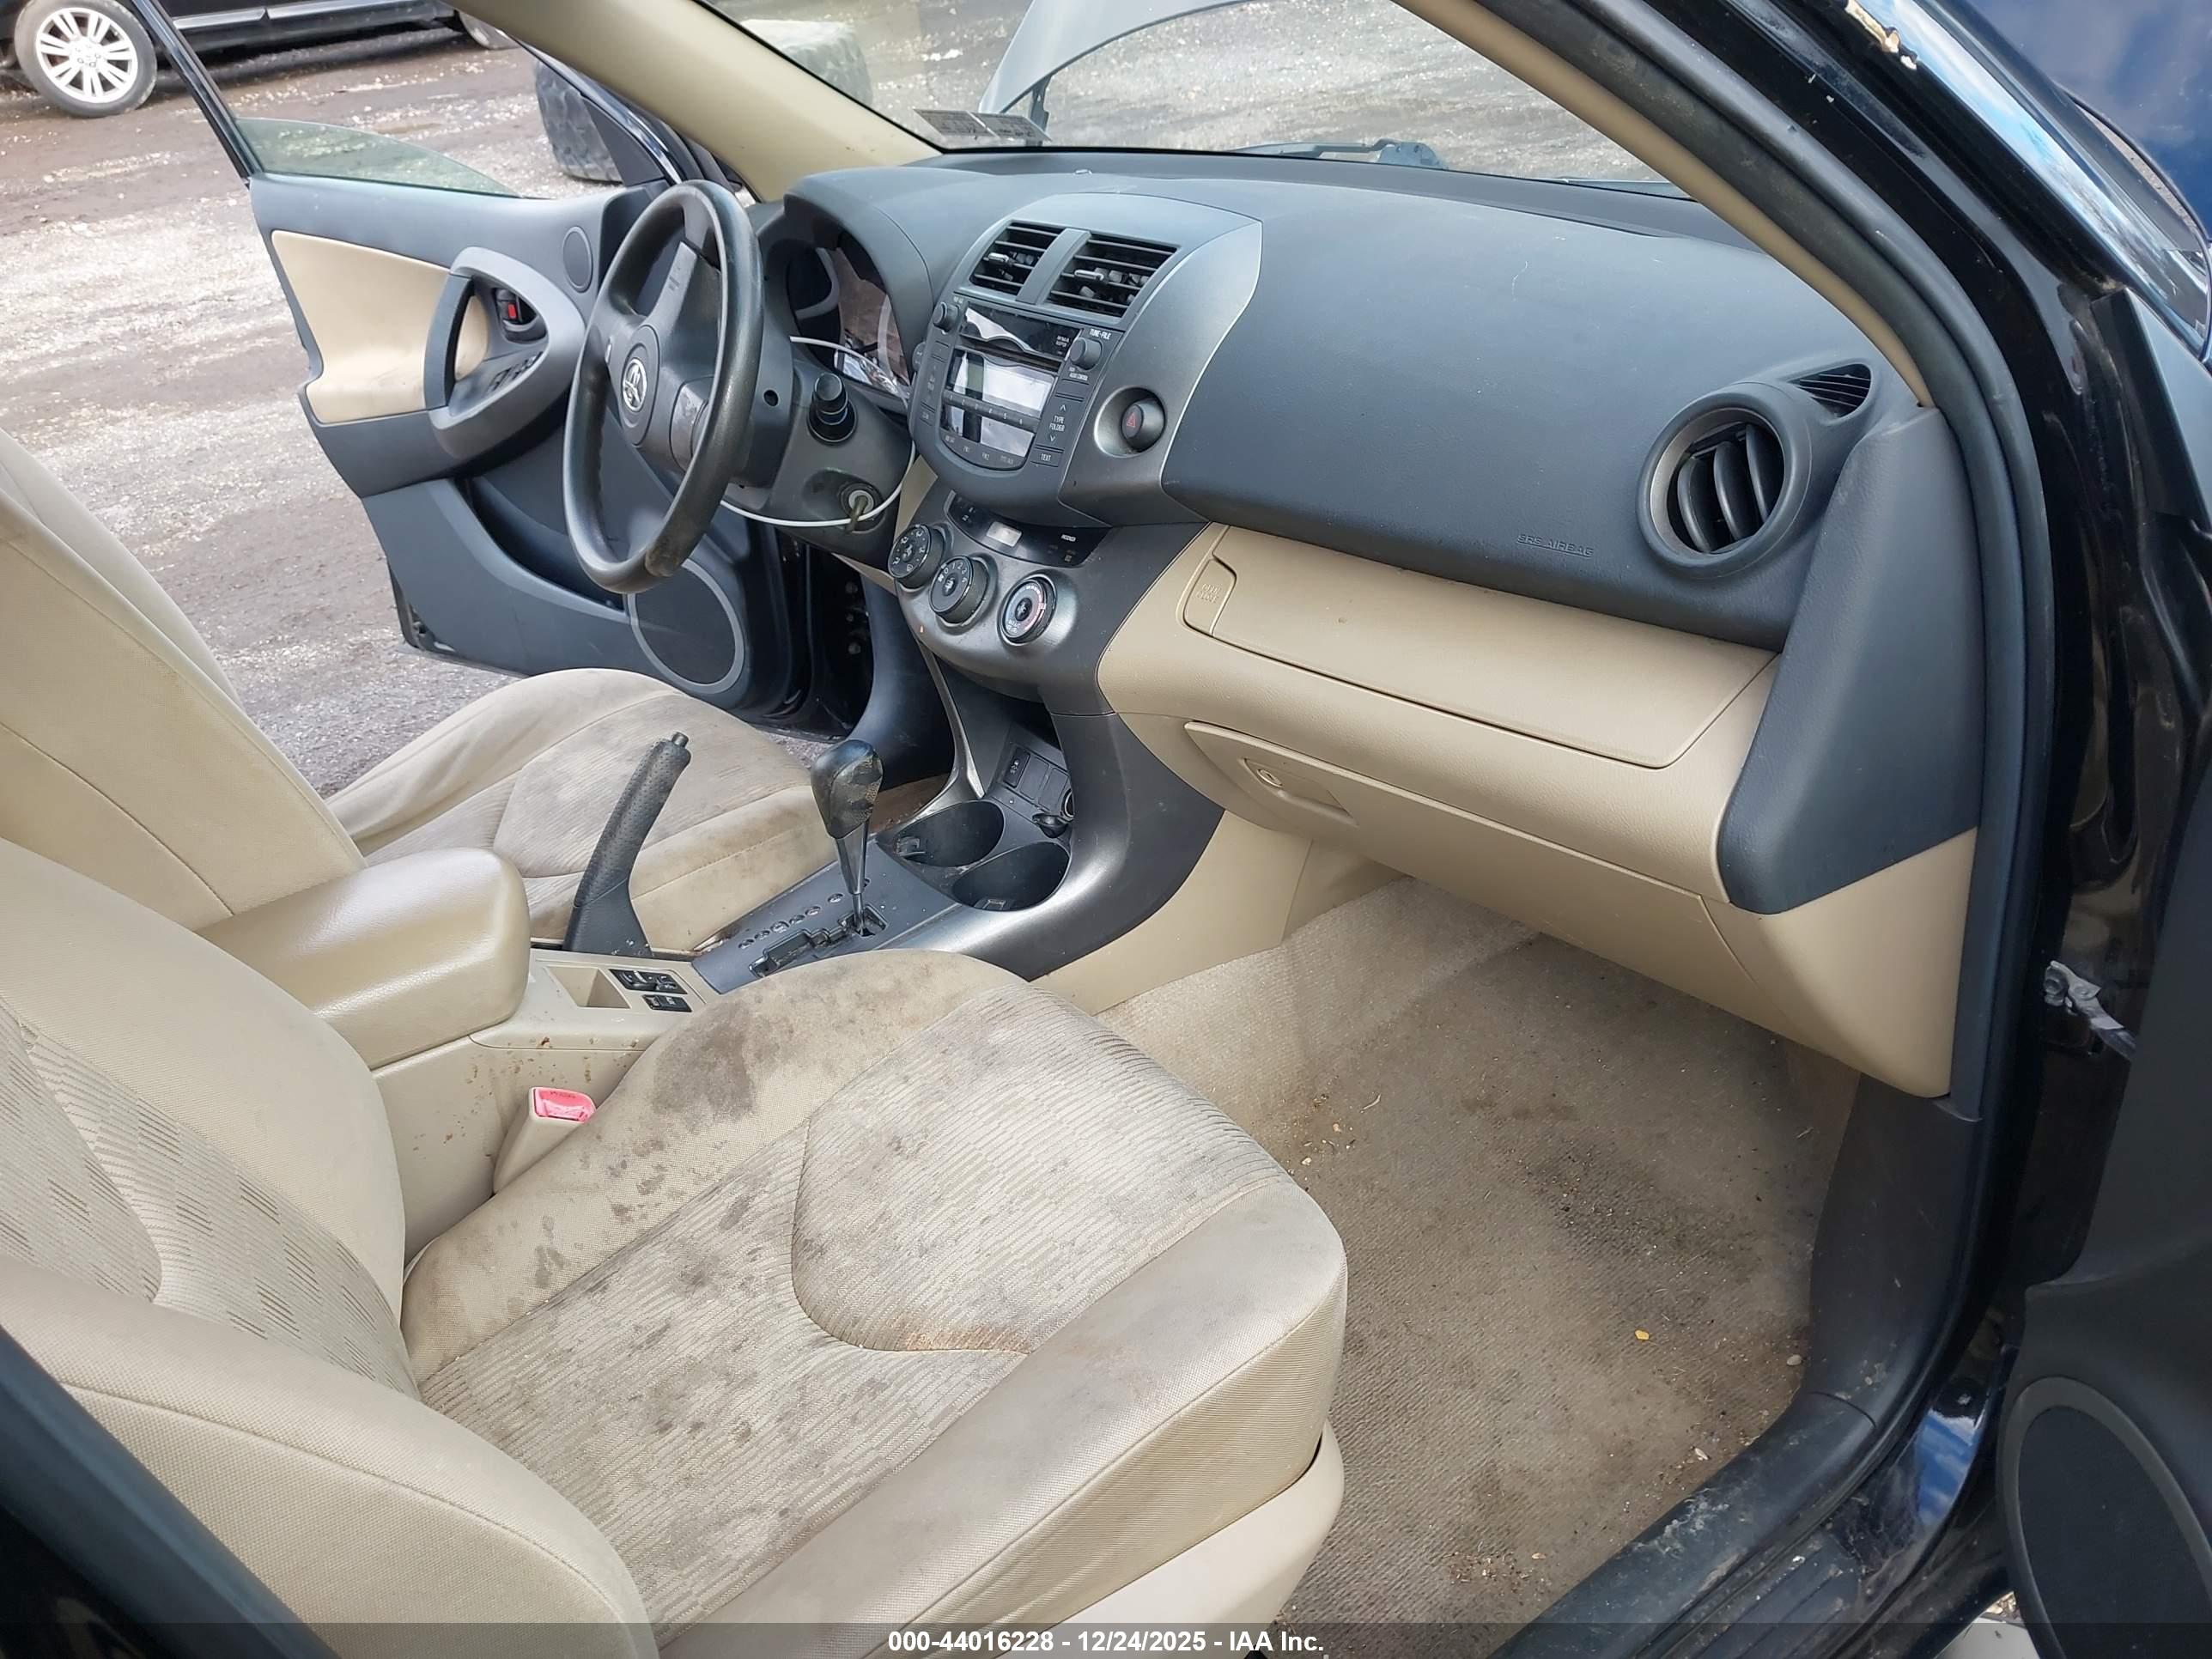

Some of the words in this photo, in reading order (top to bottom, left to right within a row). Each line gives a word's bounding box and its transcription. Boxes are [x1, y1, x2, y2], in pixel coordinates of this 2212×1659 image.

[1054, 415, 1065, 424] TYPE
[1049, 422, 1066, 432] FOLDER
[1041, 453, 1052, 462] TEXT
[1517, 534, 1542, 544] SRS
[1547, 538, 1594, 556] AIRBAG
